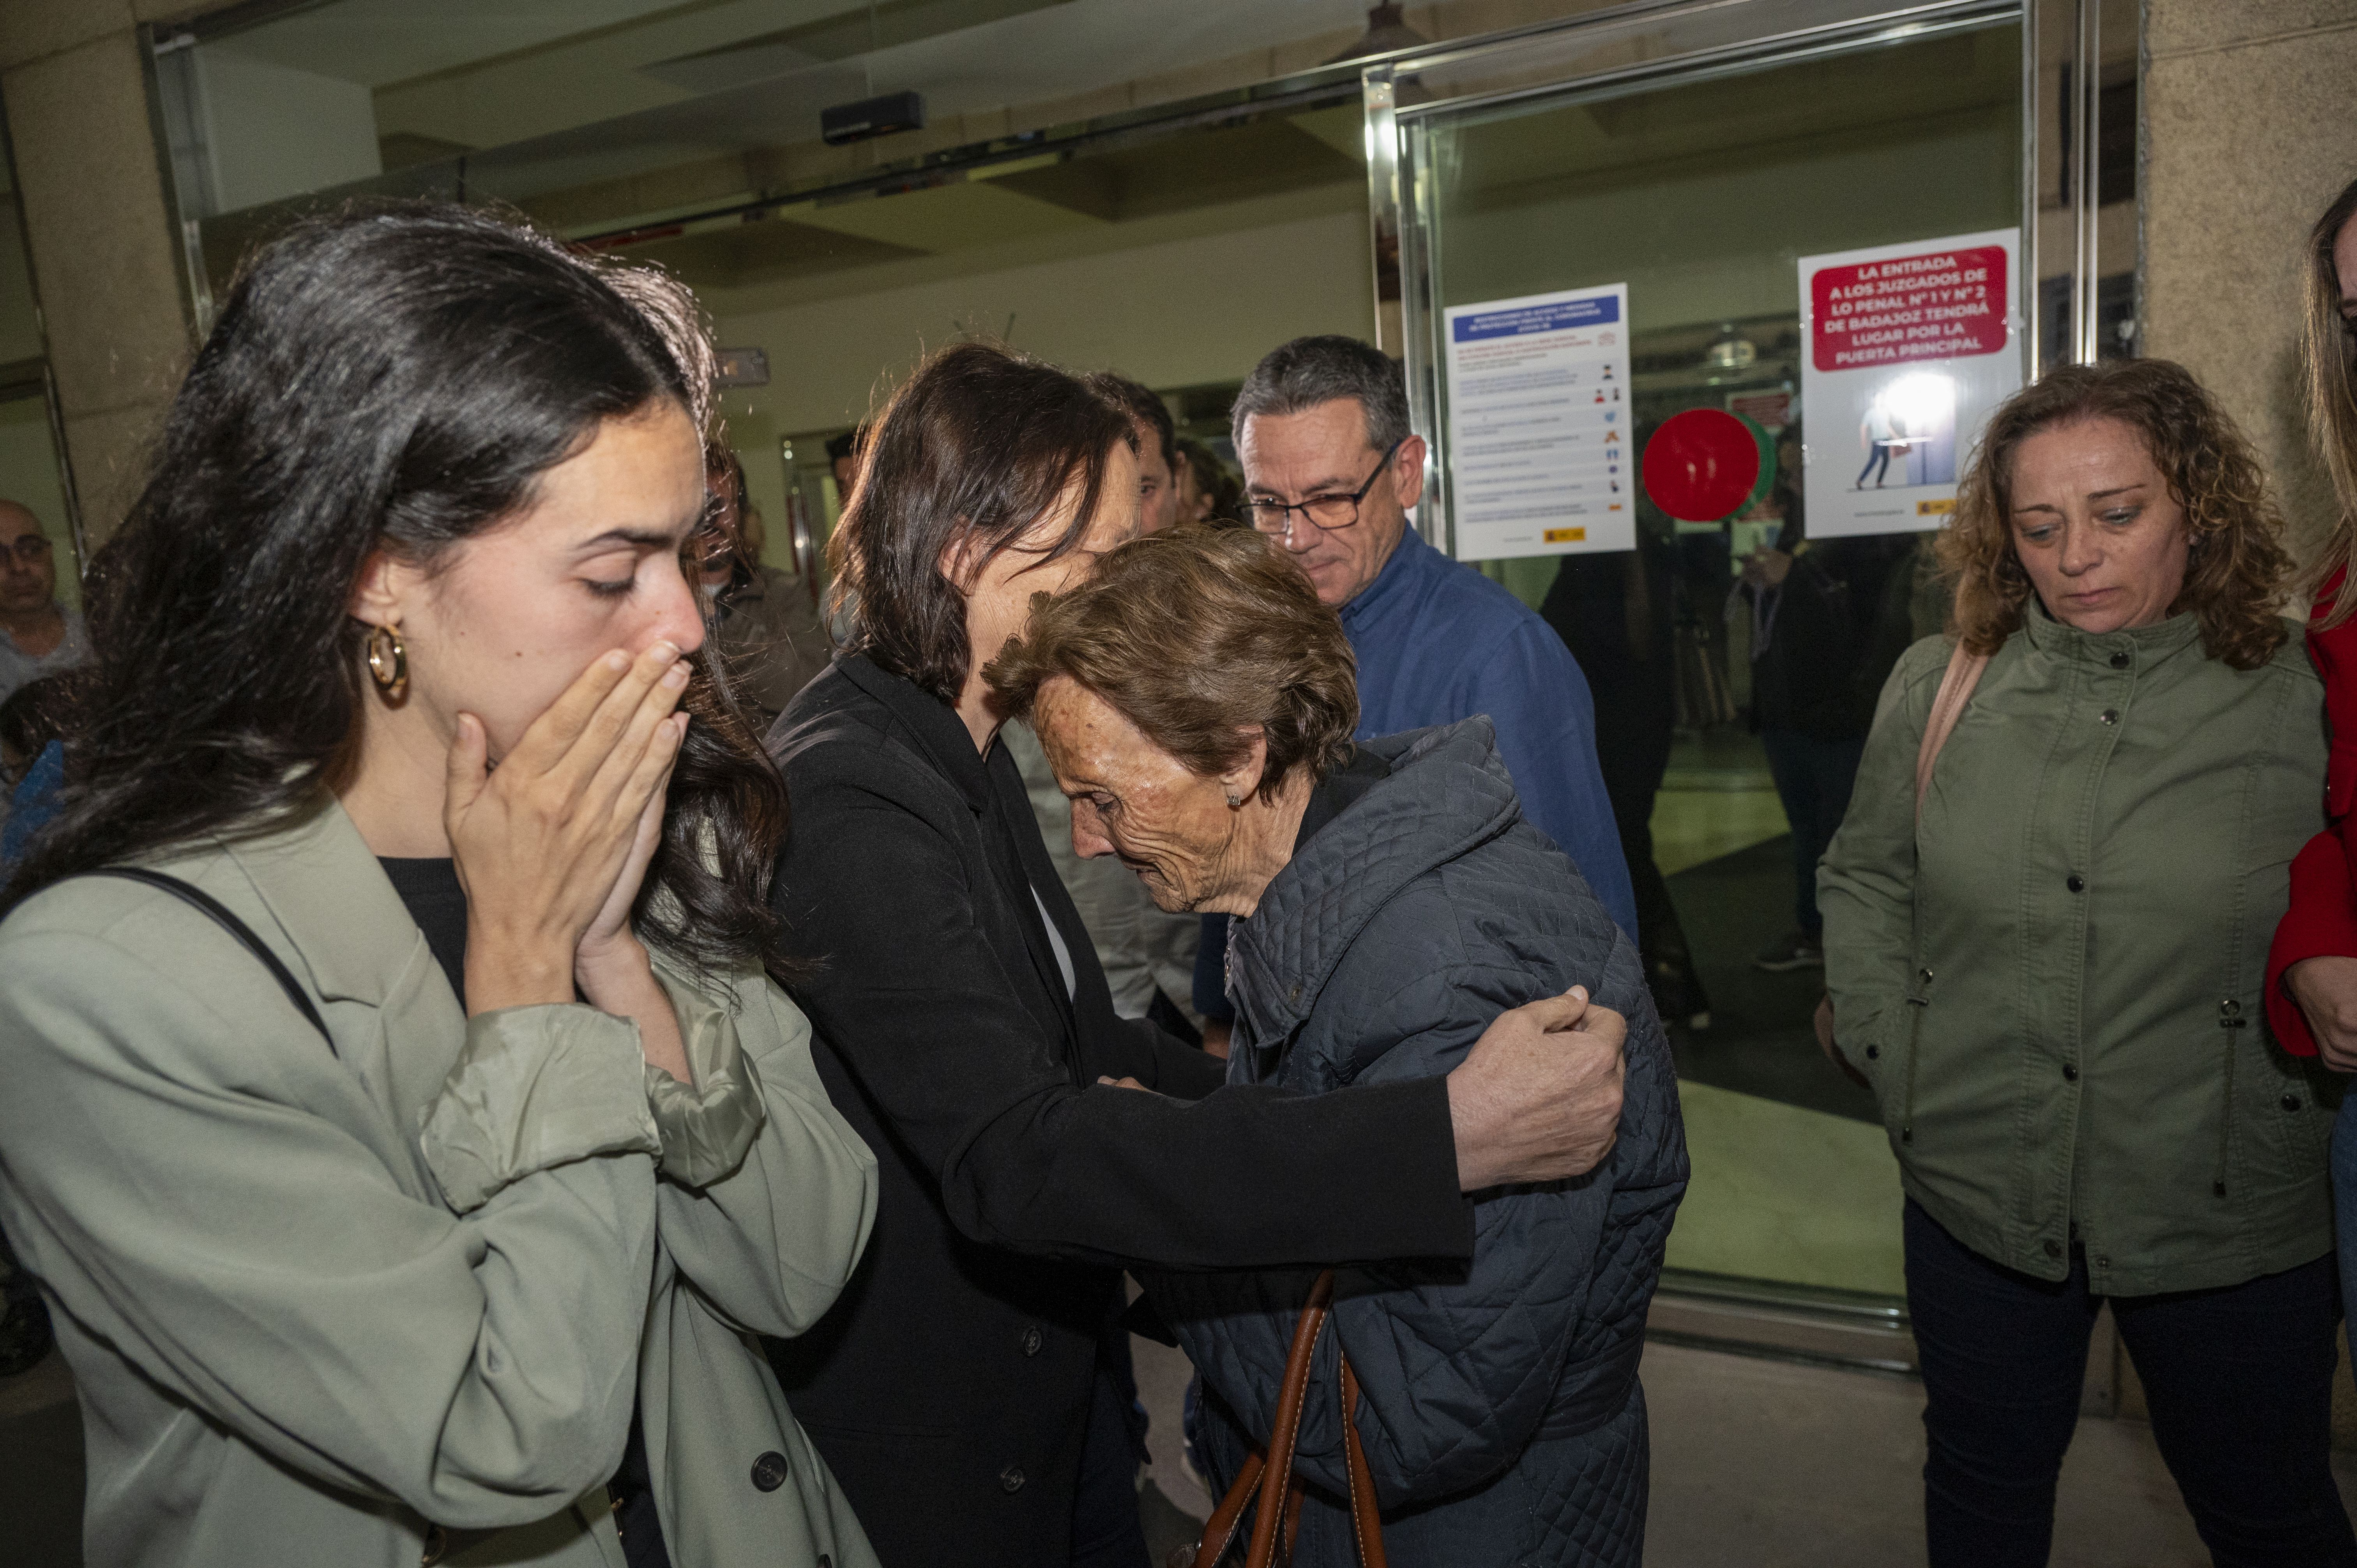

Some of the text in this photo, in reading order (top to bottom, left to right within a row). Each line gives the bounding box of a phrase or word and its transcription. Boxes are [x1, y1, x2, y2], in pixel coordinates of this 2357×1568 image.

[1858, 257, 1956, 280] LA ENTRADA
[1830, 268, 1987, 300] A LOS JUZGADOS DE
[1832, 303, 1853, 316] LO
[1855, 297, 1905, 312] PENAL
[1932, 290, 1936, 303] 1
[1942, 289, 1952, 301] Y
[1975, 286, 1986, 298] 2
[1825, 301, 1989, 333] DE BADAJOZ TENDRÁ
[1852, 322, 1964, 346] LUGAR POR LA
[1836, 337, 1982, 365] PUERTA PRINCIPAL
